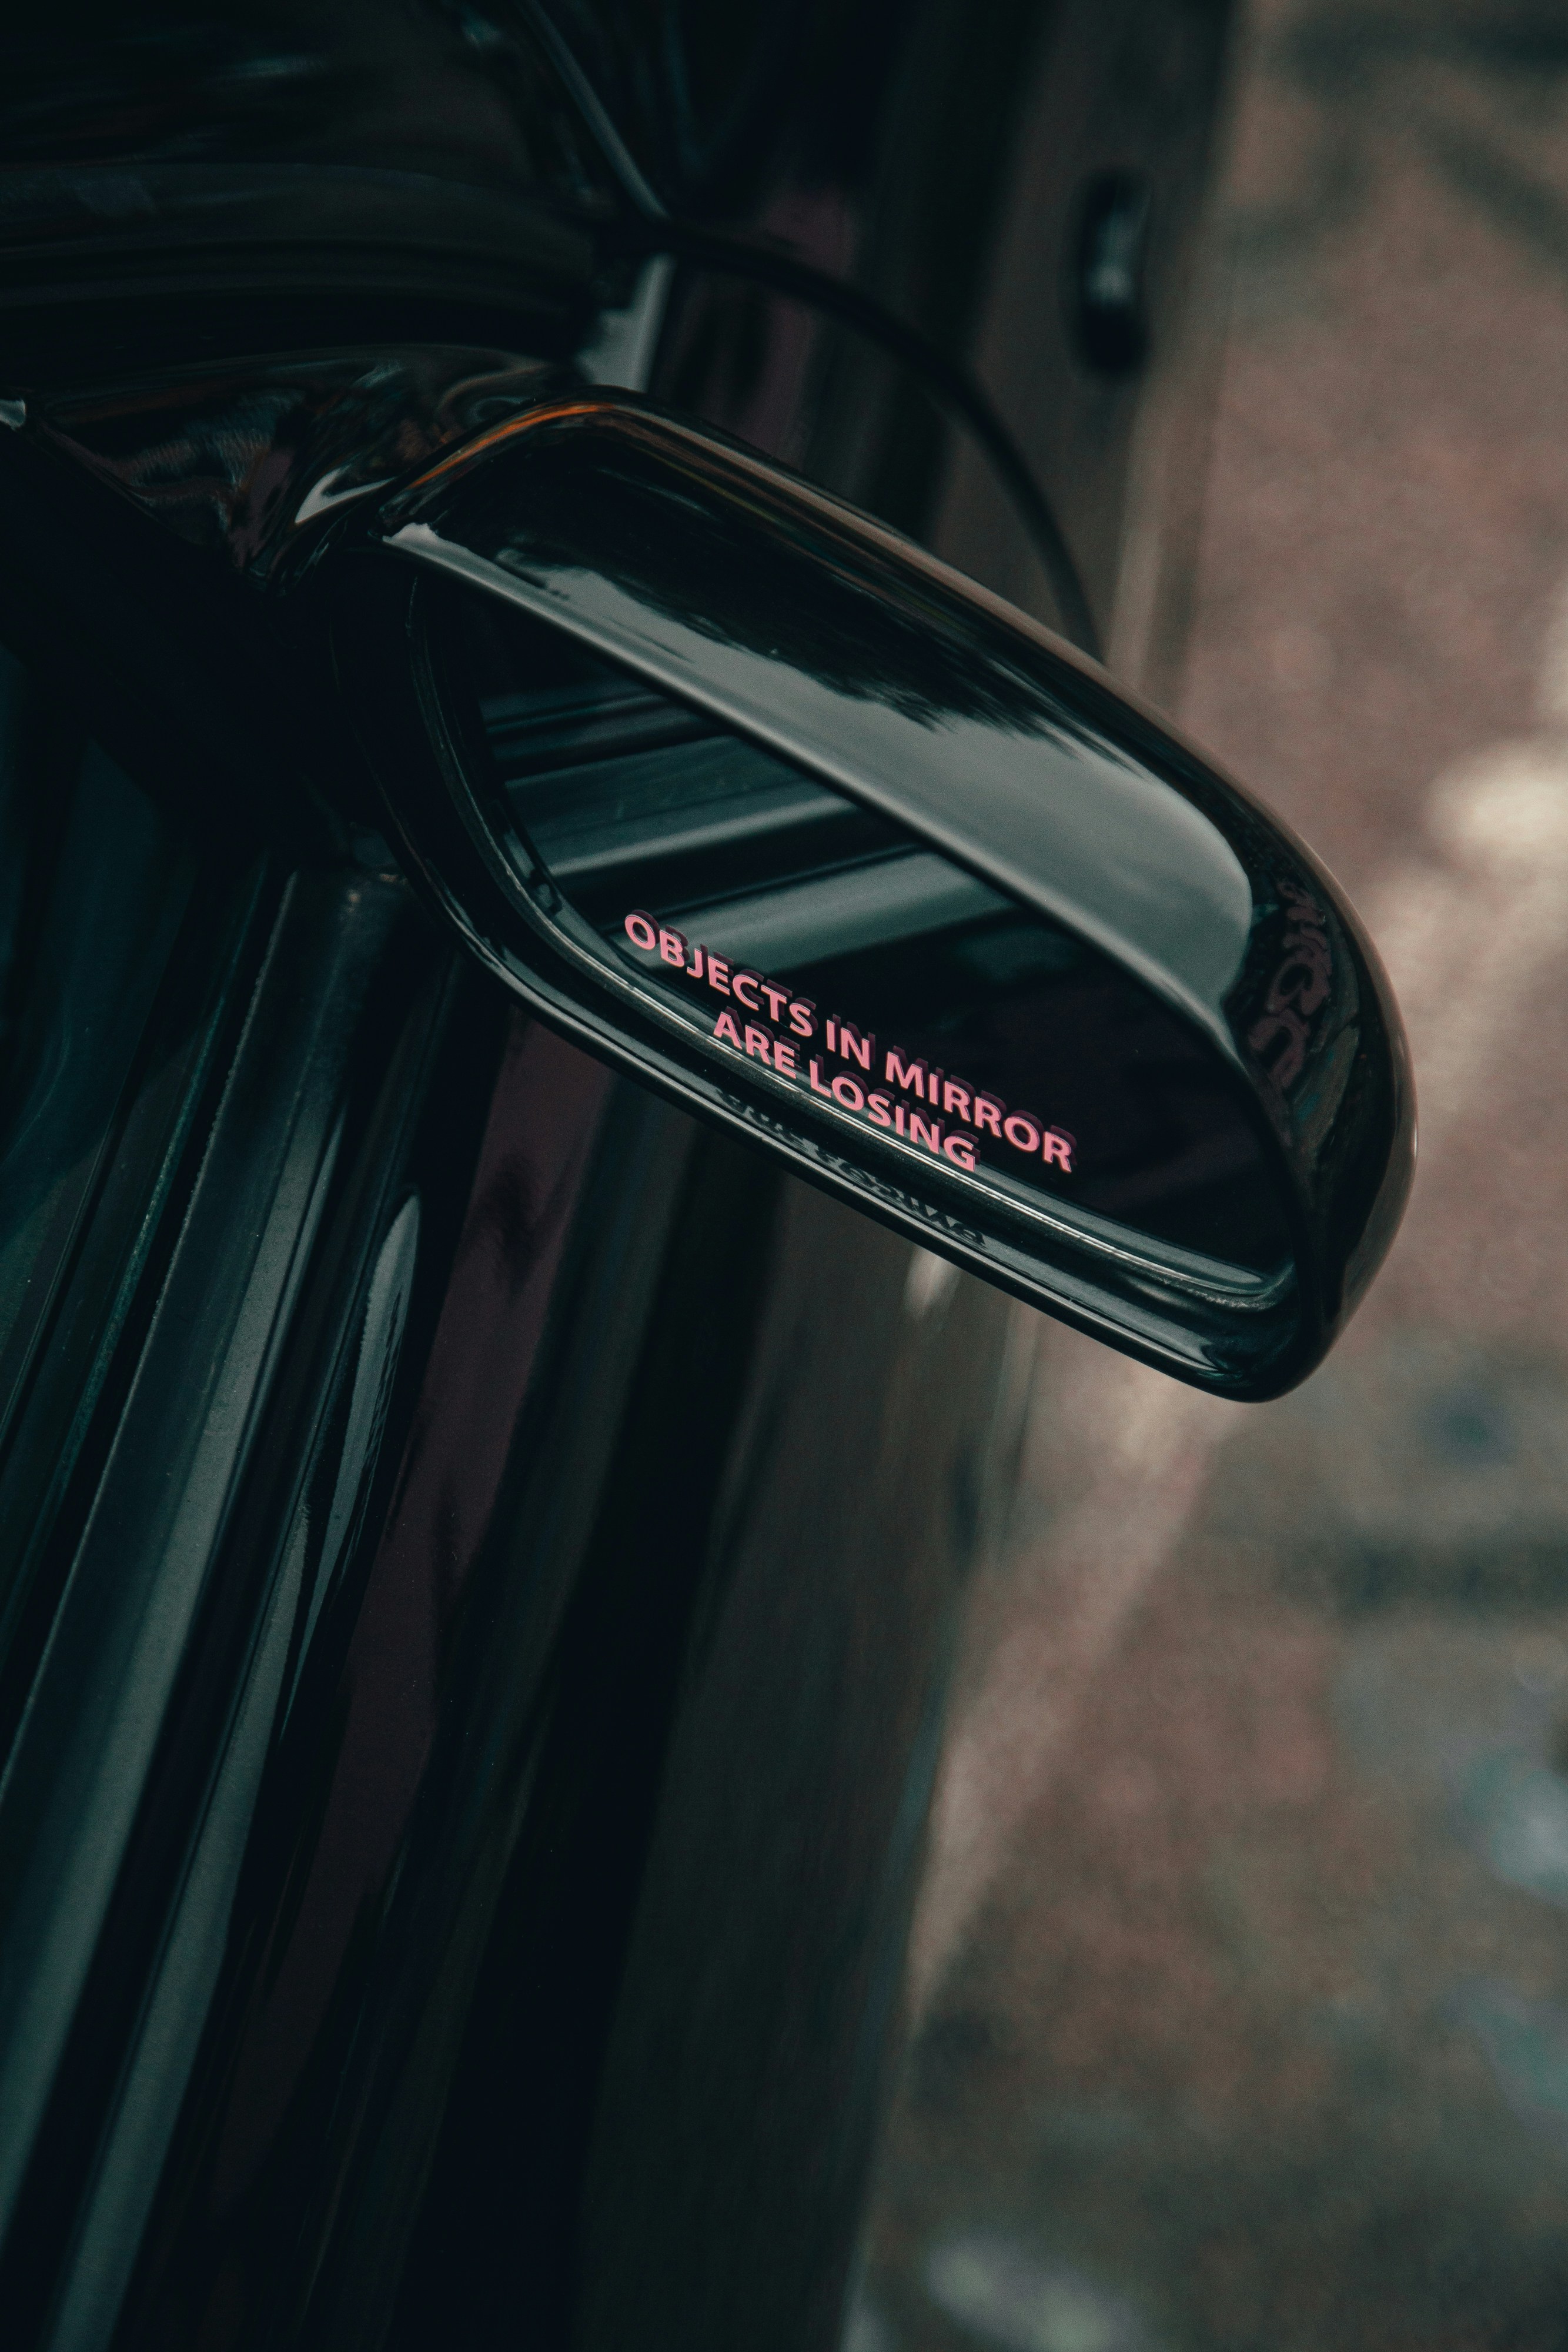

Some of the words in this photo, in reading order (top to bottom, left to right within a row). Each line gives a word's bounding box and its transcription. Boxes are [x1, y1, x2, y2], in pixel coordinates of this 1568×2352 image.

[624, 914, 814, 1038] OBJECTS
[825, 1019, 871, 1070] IN
[885, 1051, 1072, 1172] MIRROR
[713, 1011, 797, 1080] ARE
[809, 1059, 976, 1172] LOSING
